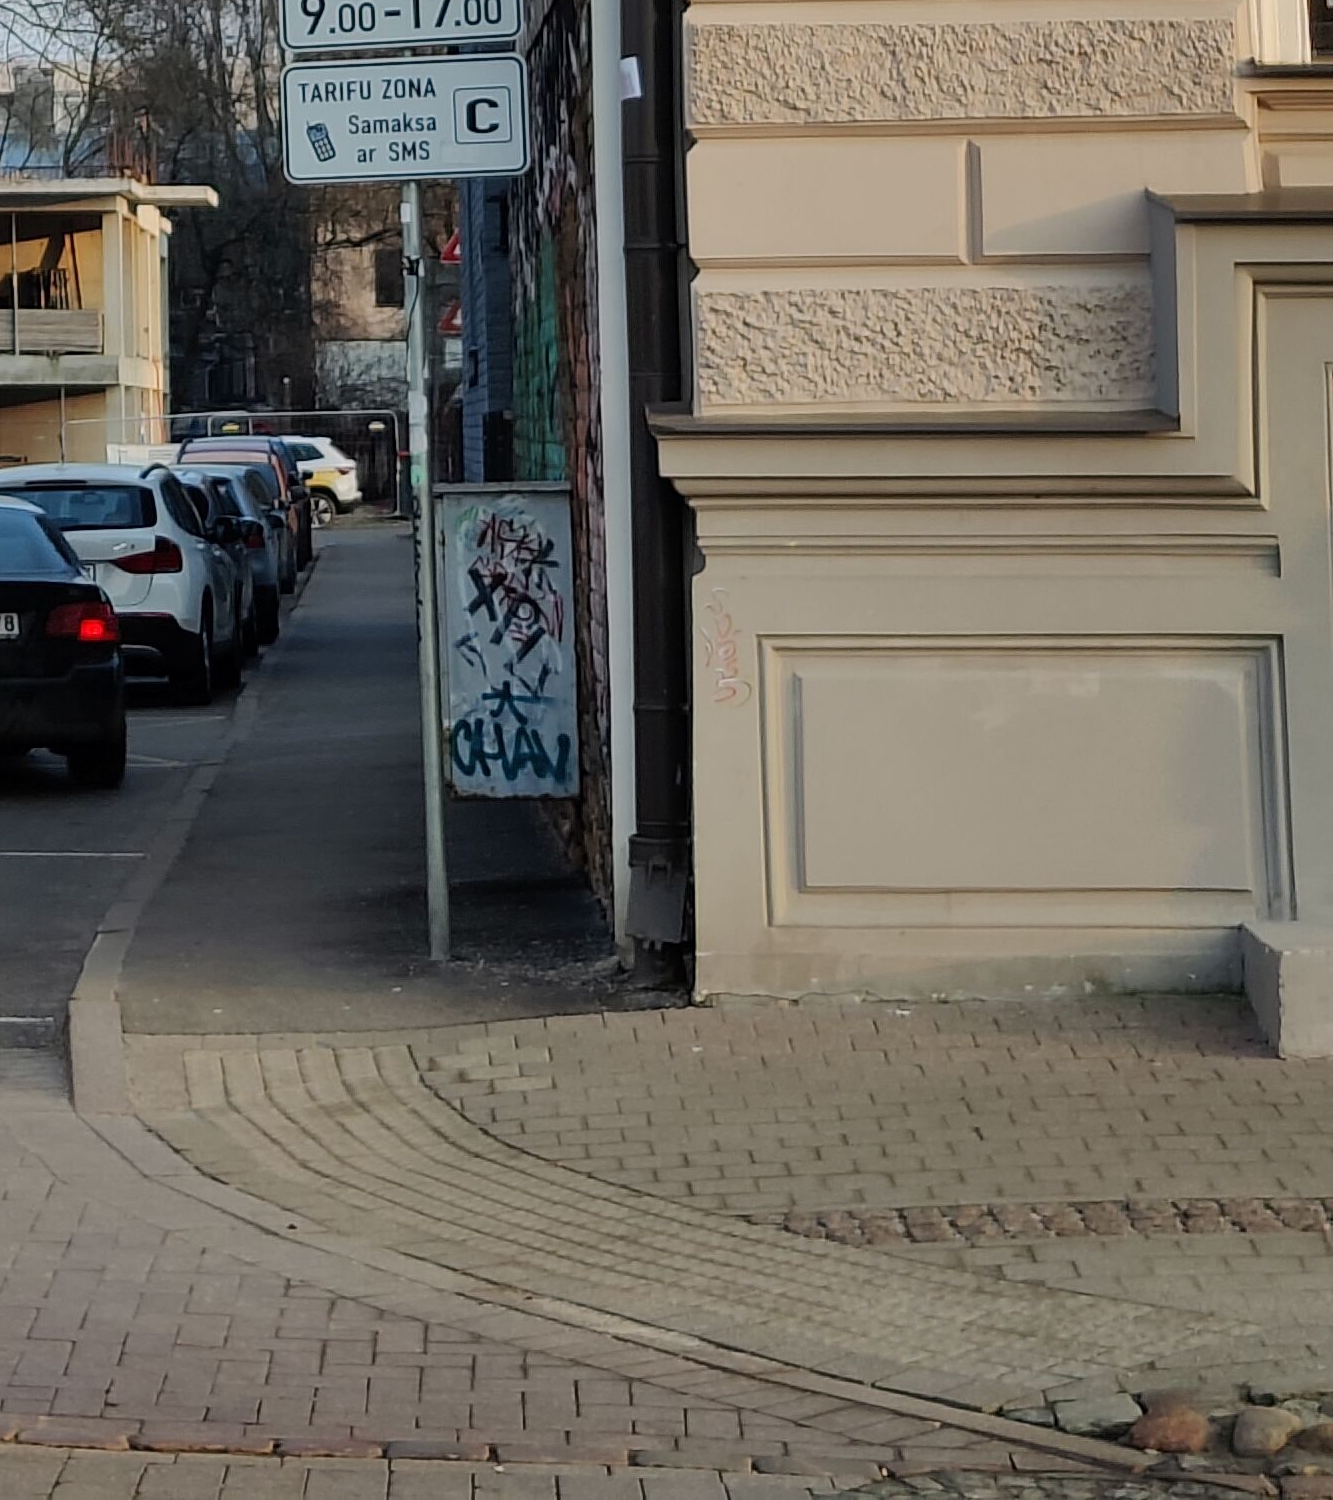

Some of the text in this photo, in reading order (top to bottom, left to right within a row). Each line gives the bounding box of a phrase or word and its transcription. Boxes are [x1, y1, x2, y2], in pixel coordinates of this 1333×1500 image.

[298, 77, 437, 103] TARIFU ZONA
[348, 112, 437, 135] Samaksa
[466, 98, 500, 134] C
[356, 141, 430, 163] ar SMS
